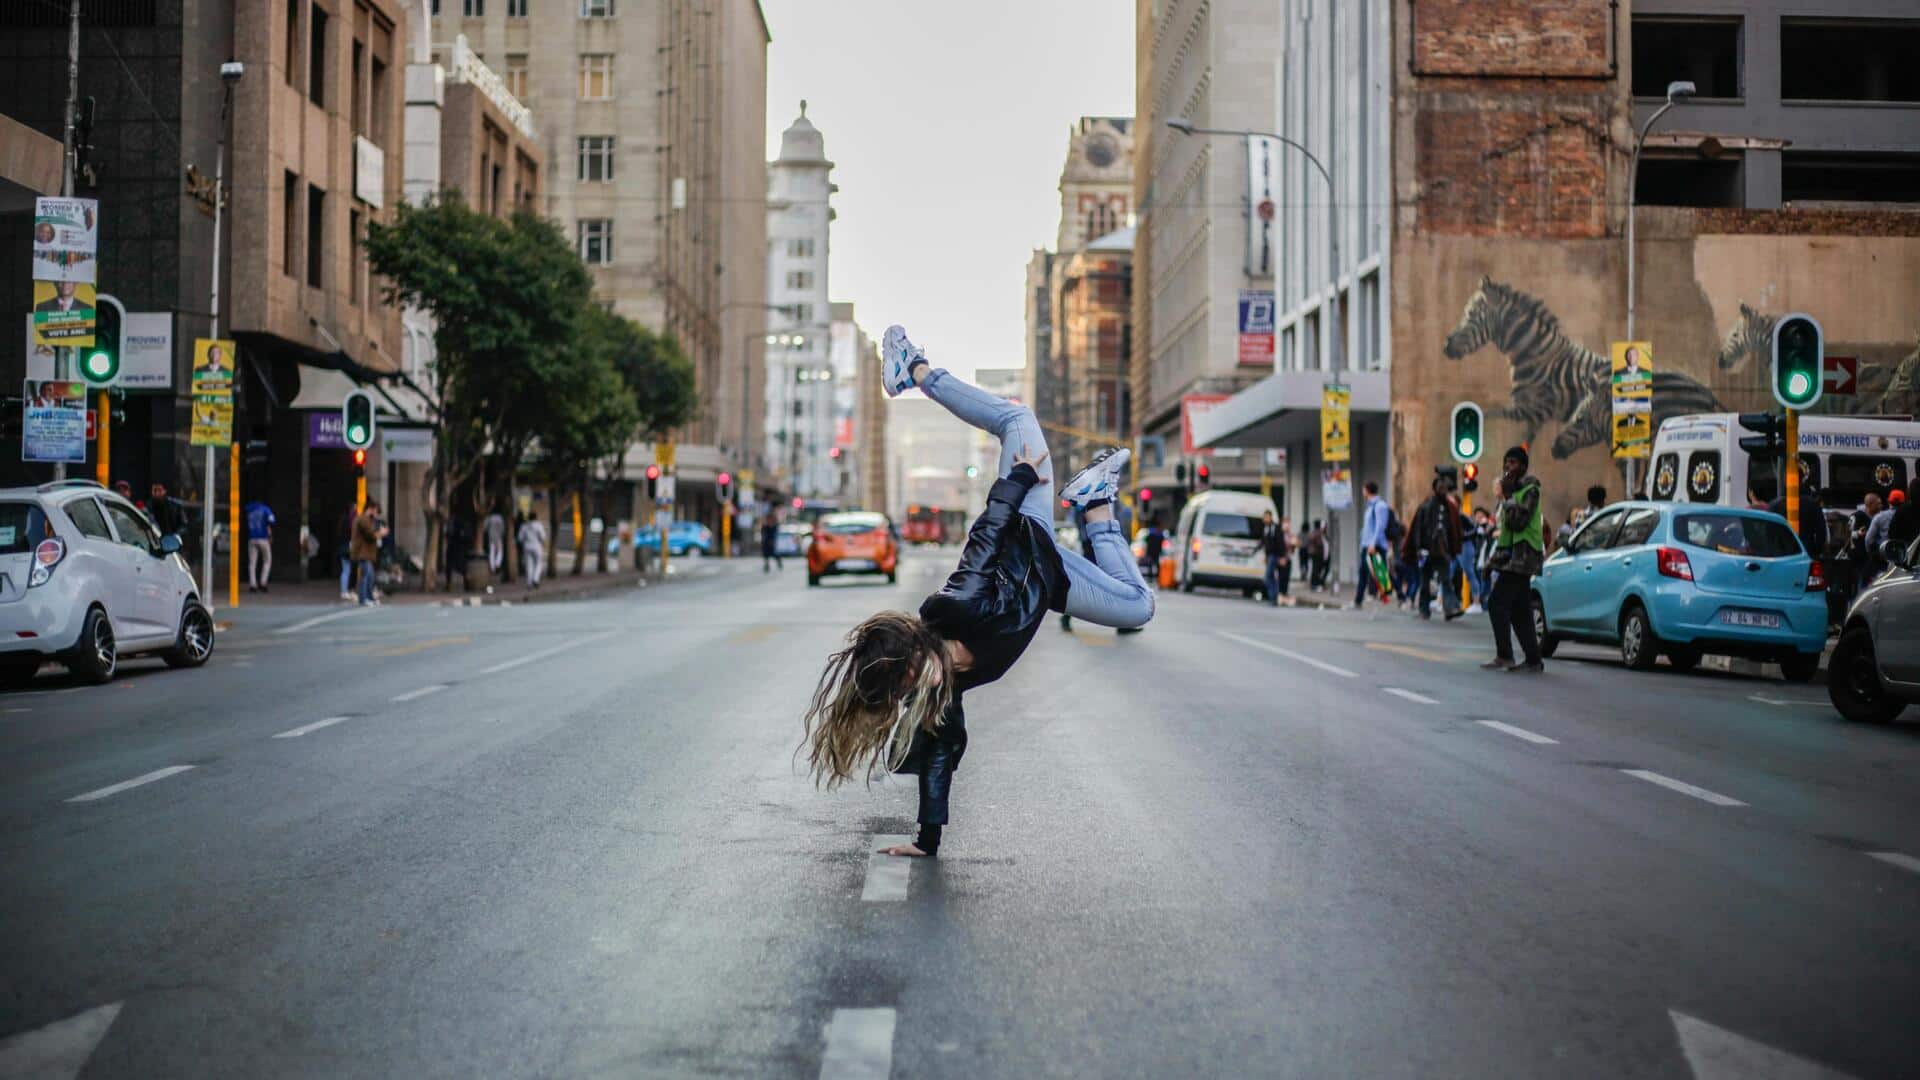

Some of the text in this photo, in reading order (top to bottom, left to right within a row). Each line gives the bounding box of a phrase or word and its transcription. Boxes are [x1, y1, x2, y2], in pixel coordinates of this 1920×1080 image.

[126, 336, 166, 345] PROVINCE
[1821, 434, 1832, 446] TO
[1834, 434, 1870, 448] PROTECT
